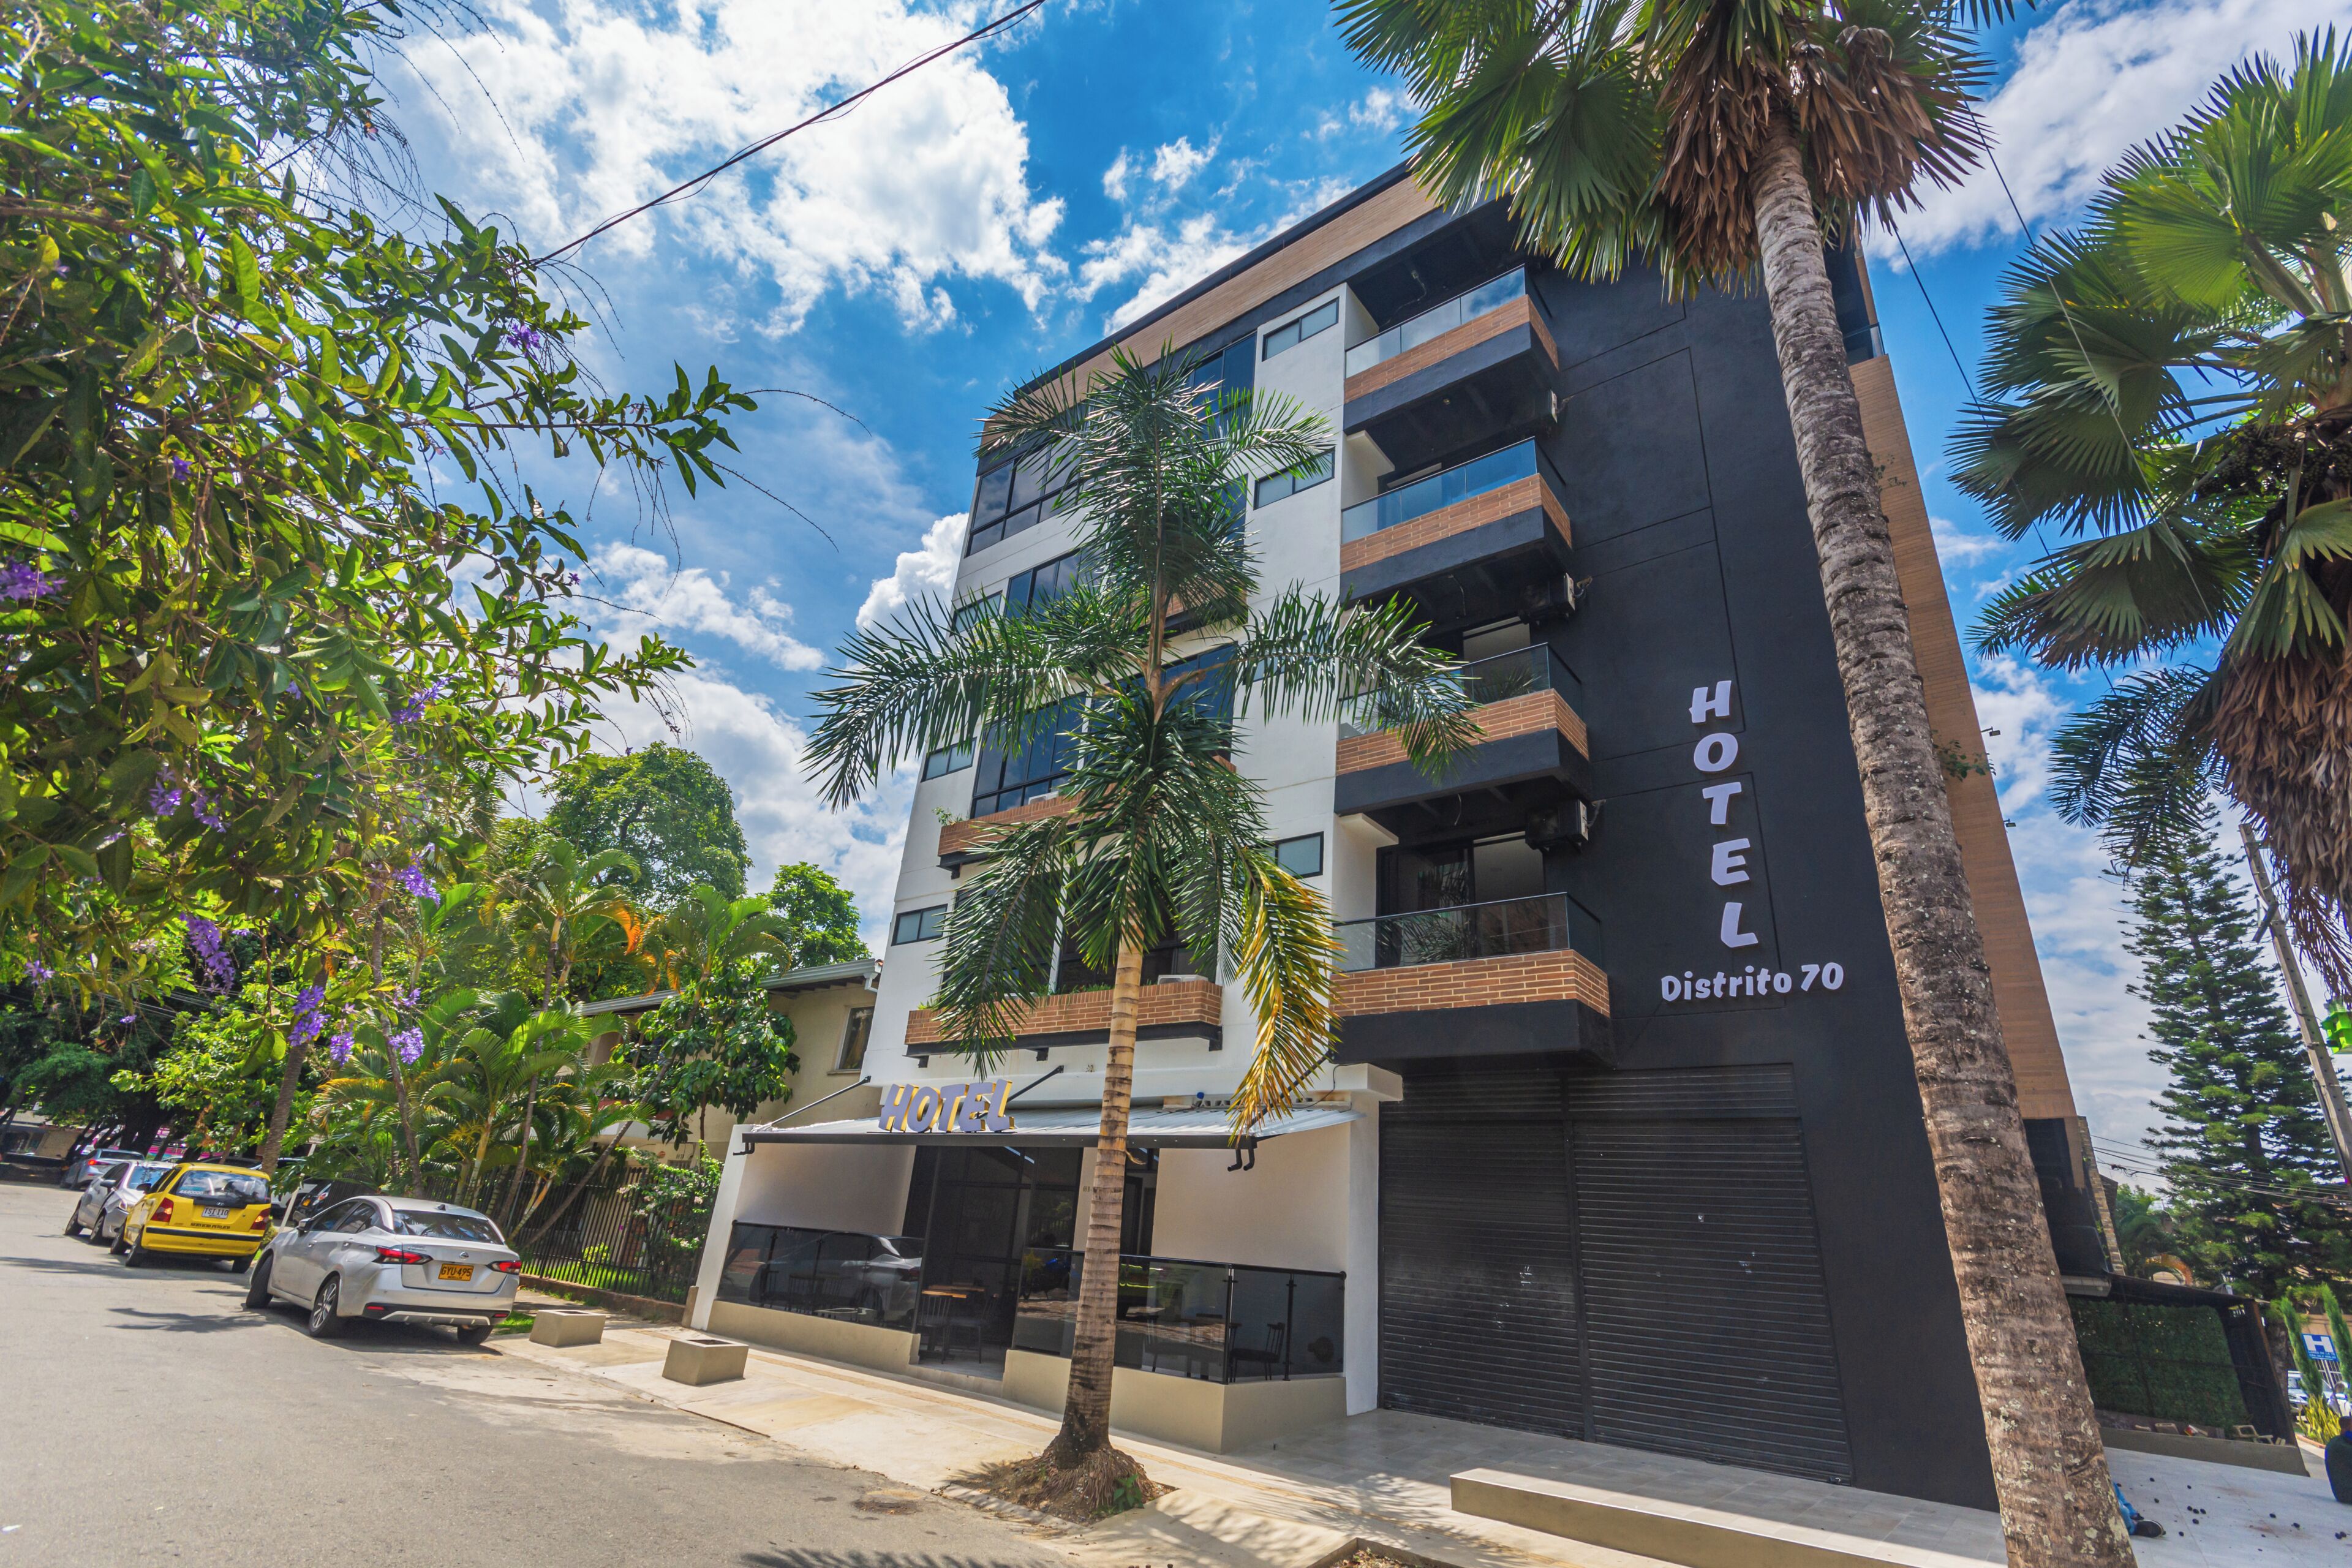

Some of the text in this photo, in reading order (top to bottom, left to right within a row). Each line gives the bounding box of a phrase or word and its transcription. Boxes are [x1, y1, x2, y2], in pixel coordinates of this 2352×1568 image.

[1689, 680, 1758, 948] HOTEL
[1660, 962, 1844, 1002] Distrito 70
[878, 1079, 1015, 1133] HOTEL
[2303, 1335, 2334, 1352] H
